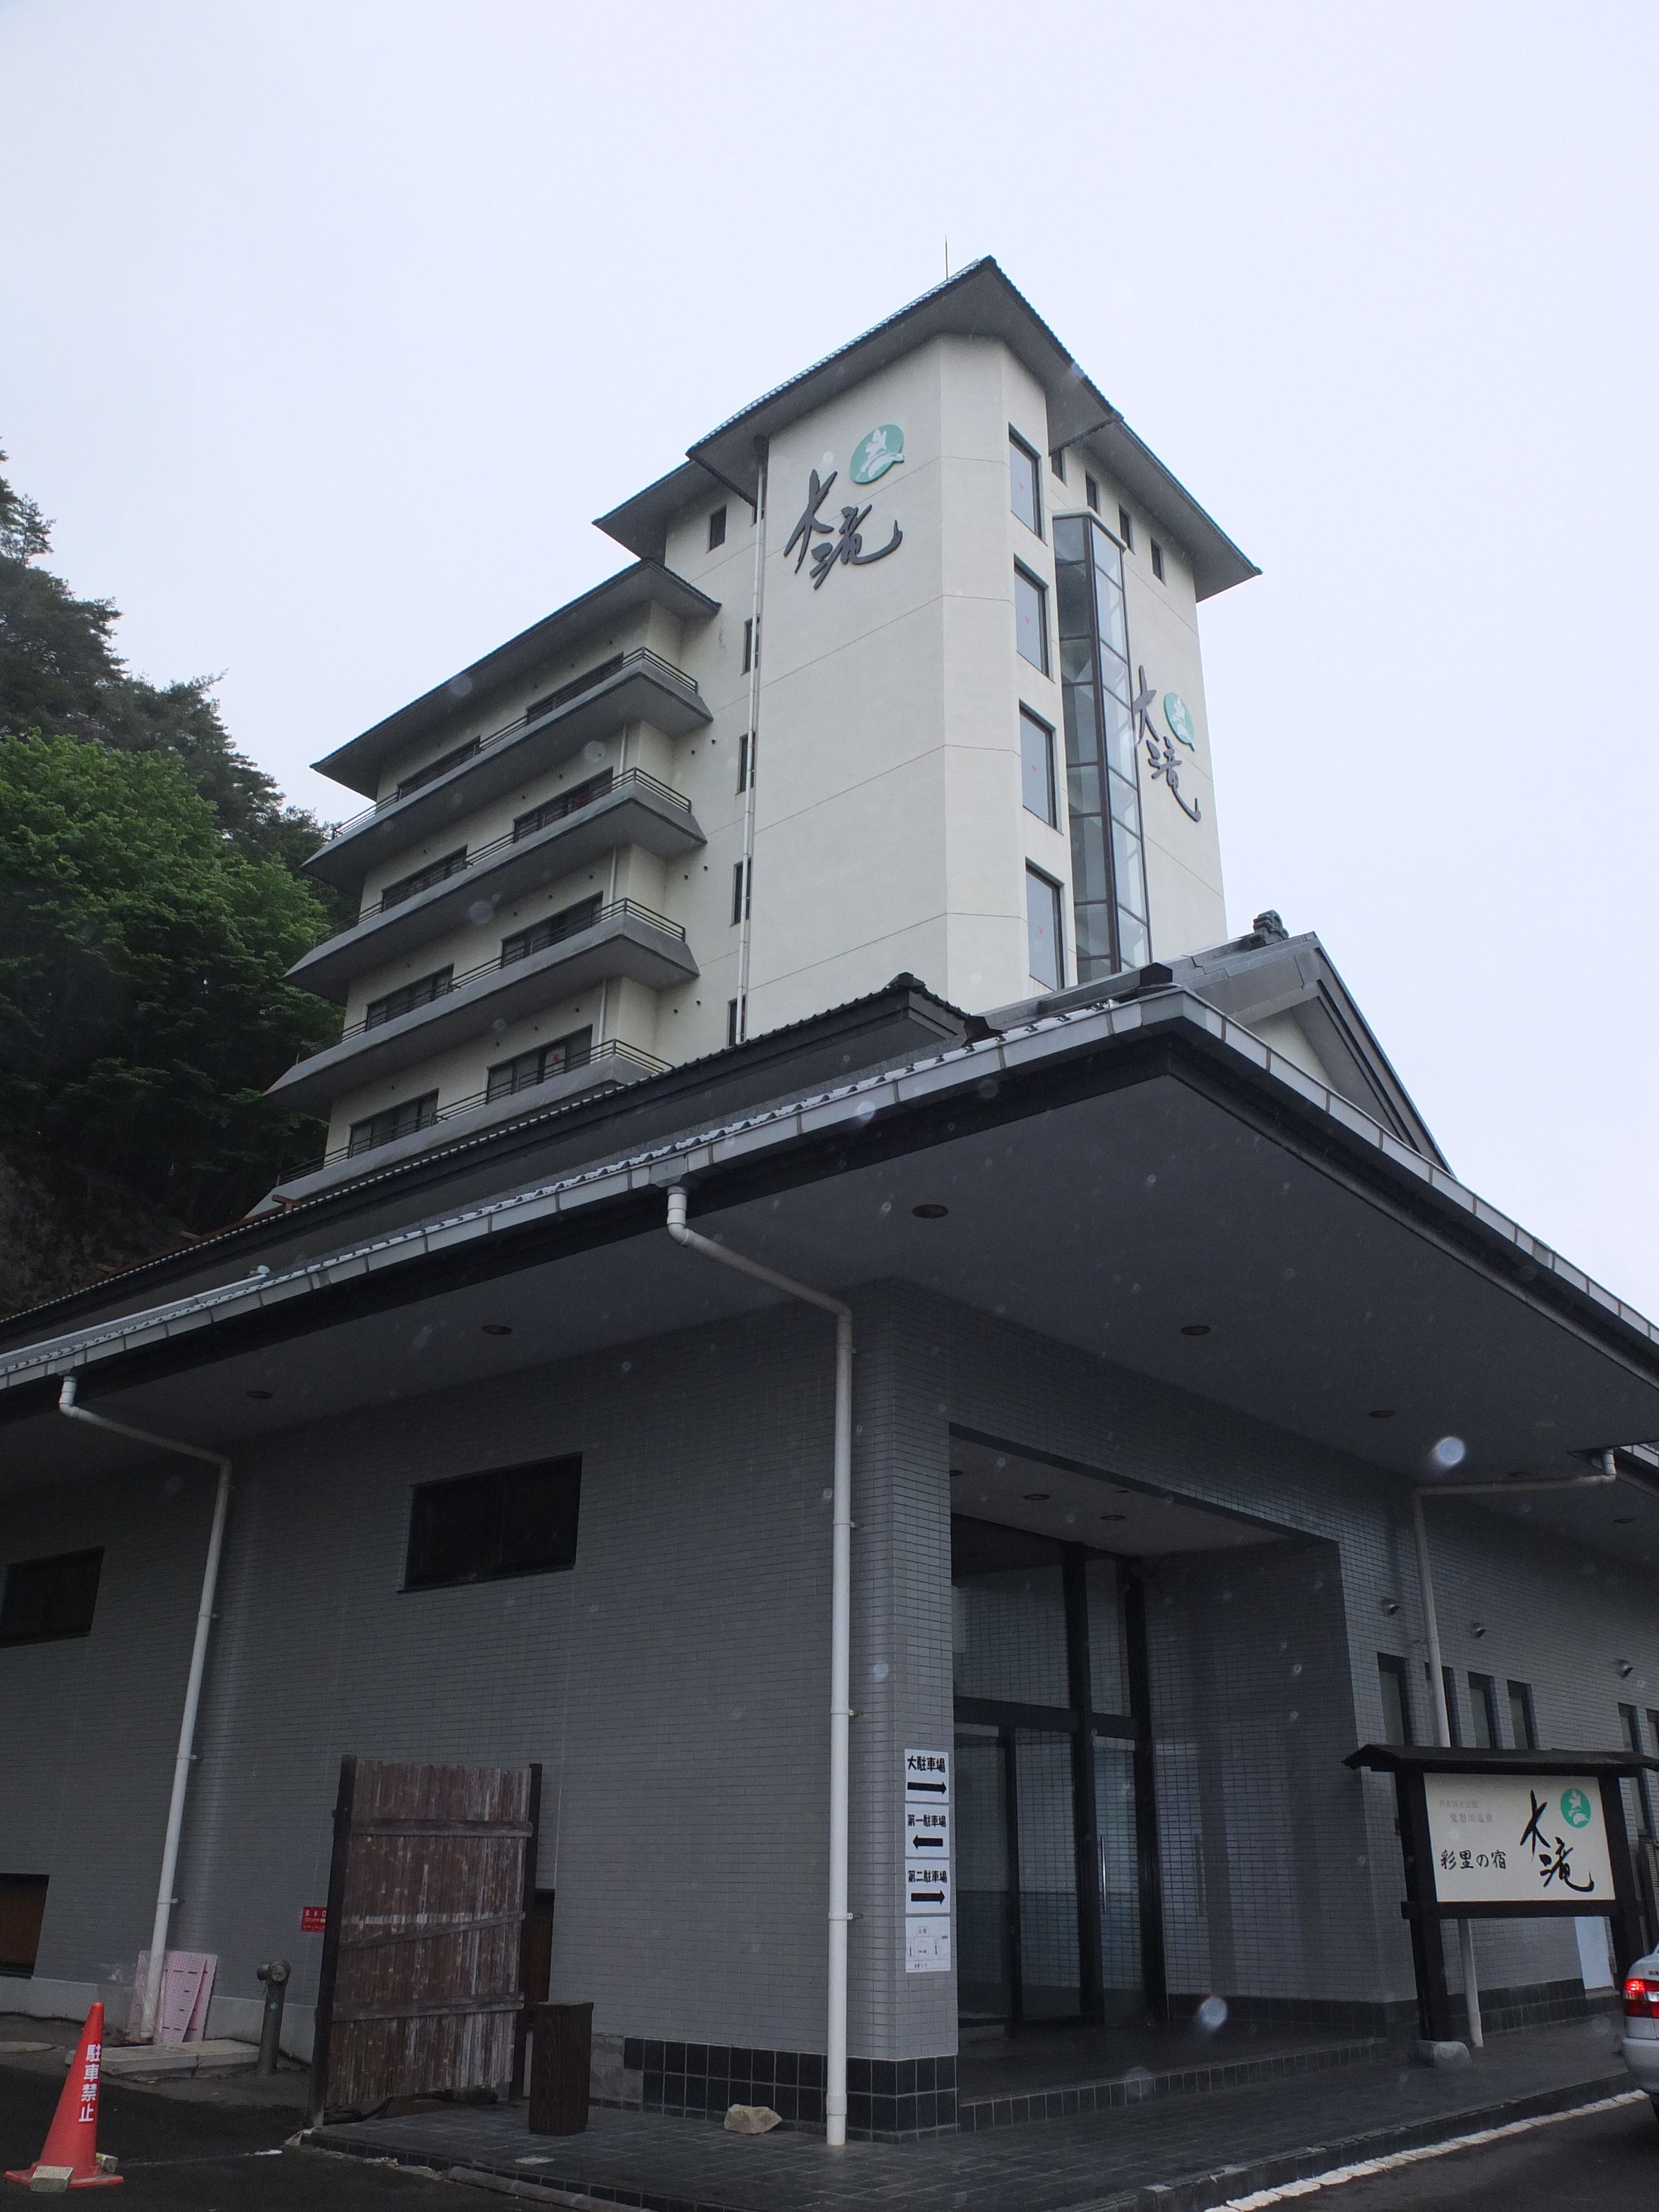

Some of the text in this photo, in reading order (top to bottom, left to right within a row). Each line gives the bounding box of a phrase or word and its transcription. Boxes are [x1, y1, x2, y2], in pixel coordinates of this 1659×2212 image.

[907, 1755, 945, 1772] 大駐車場
[908, 1814, 946, 1827] 第一駐車場
[1440, 1849, 1506, 1870] 彩里の宿
[908, 1870, 948, 1883] 第二駐車場
[78, 2044, 101, 2122] 駐車禁止
